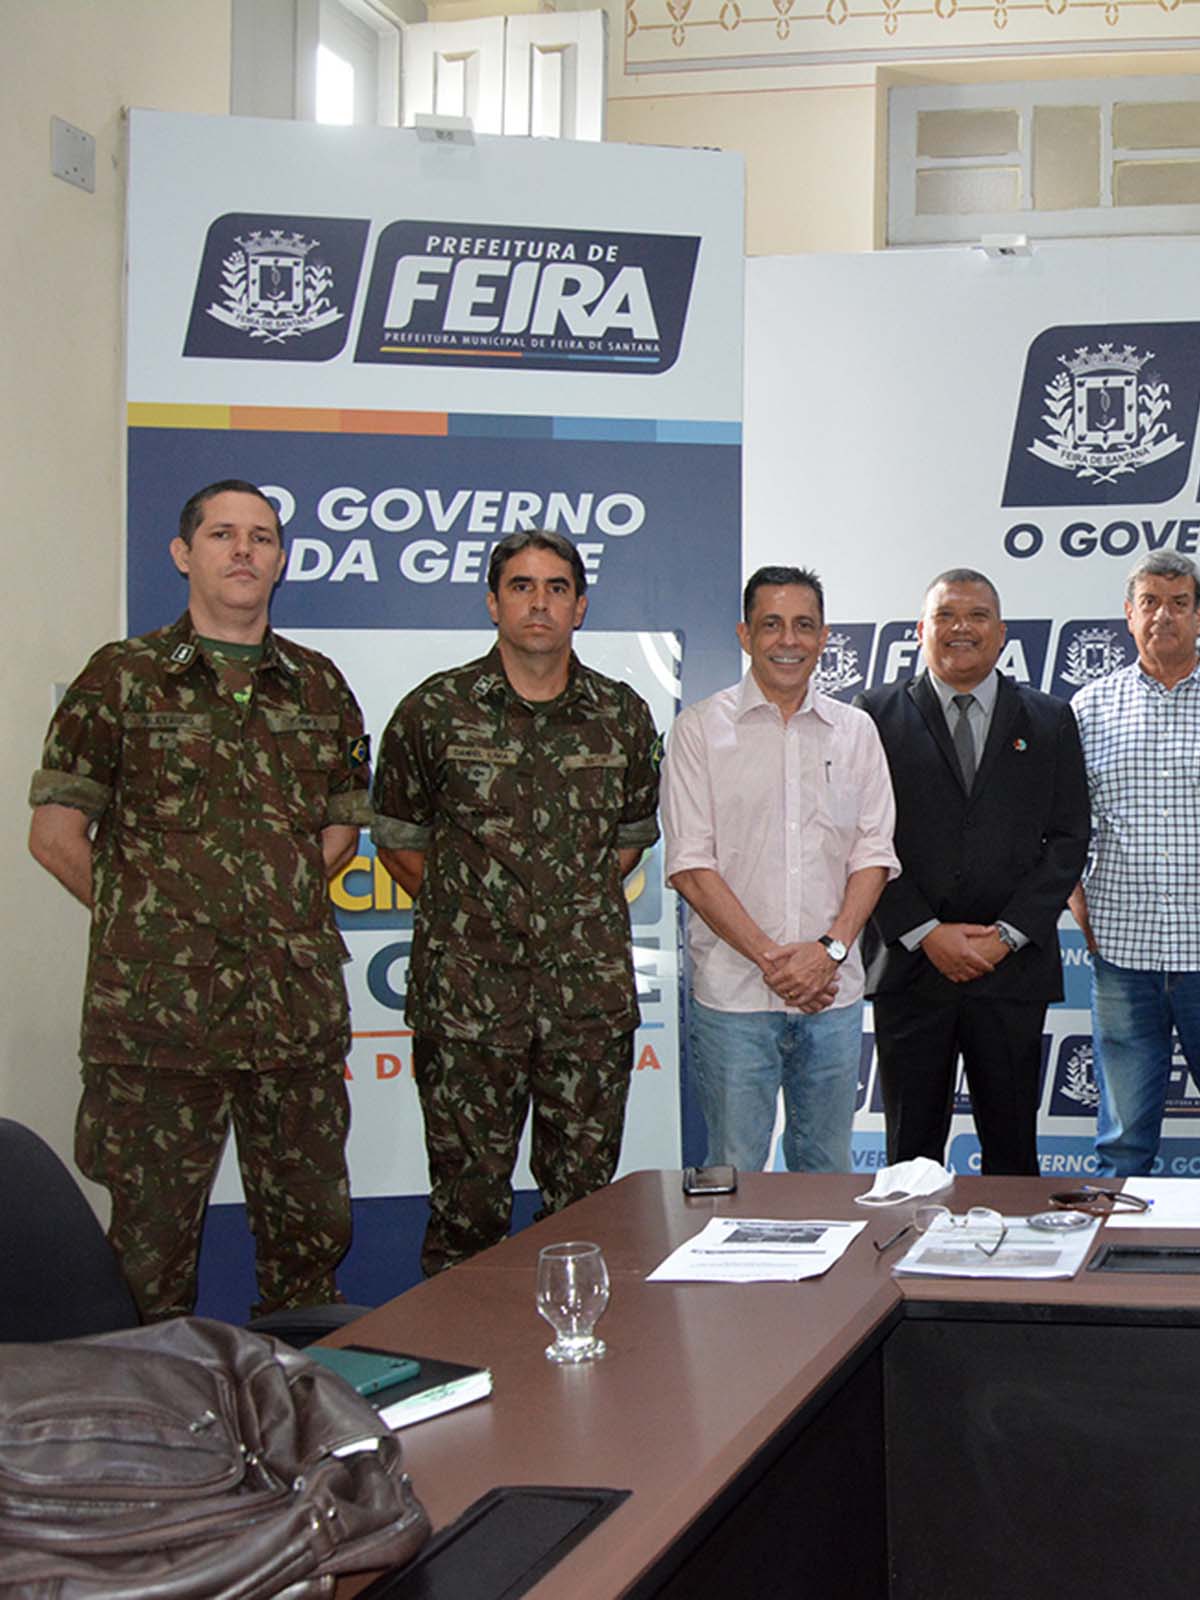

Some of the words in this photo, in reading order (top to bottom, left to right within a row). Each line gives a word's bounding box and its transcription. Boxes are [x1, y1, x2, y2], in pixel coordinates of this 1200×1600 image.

[426, 236, 576, 260] PREFEITURA
[587, 244, 619, 262] DE
[383, 255, 660, 340] FEIRA
[384, 332, 457, 345] PREFEITURA
[462, 335, 526, 348] MUNICIPAL
[531, 338, 546, 349] DE
[551, 339, 584, 350] FEIRA
[589, 340, 603, 351] DE
[607, 341, 661, 352] SANTANA
[317, 487, 646, 536] GOVERNO
[285, 538, 380, 582] DA
[1003, 522, 1044, 559] O
